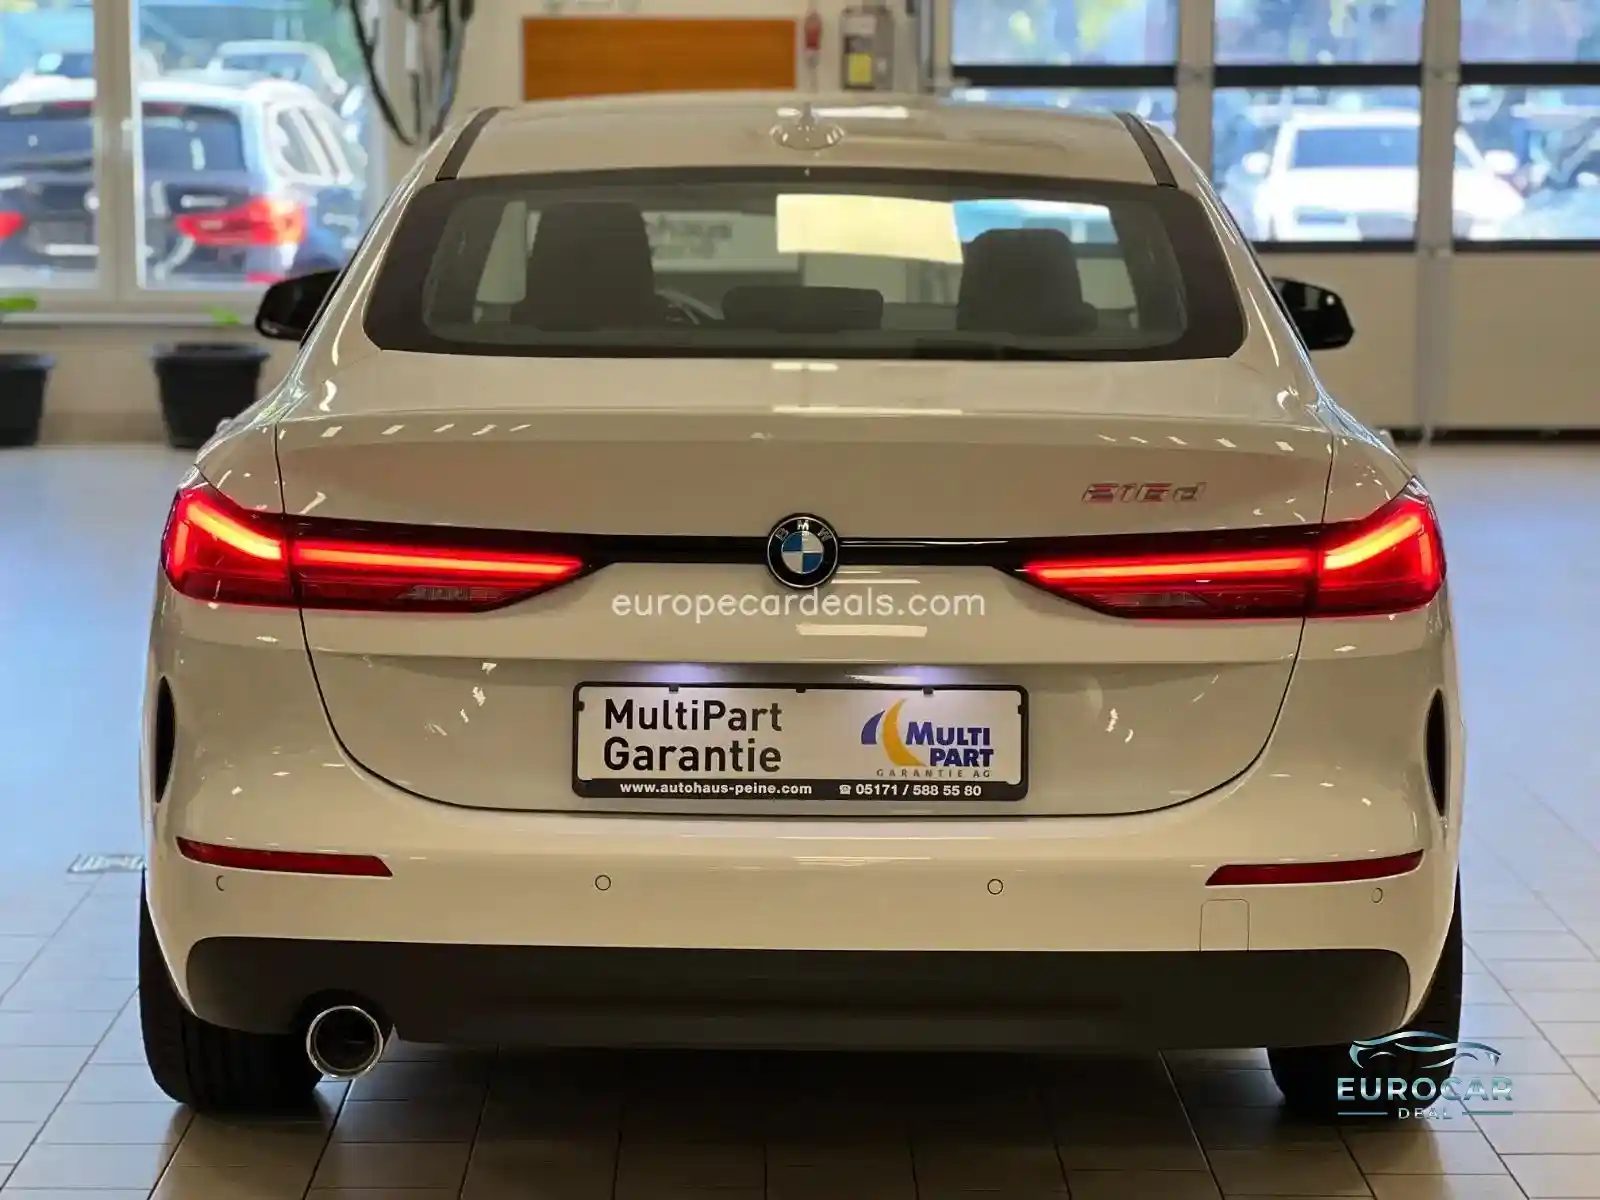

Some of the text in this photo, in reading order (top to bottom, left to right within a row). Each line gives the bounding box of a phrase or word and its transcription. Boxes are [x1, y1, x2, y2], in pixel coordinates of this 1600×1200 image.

[775, 519, 833, 542] BMW
[605, 698, 783, 732] MultiPart
[905, 721, 991, 746] MULTI
[604, 736, 782, 773] Garantie
[930, 748, 994, 767] PART
[876, 768, 991, 778] GARANTIE AG
[620, 782, 813, 796] www.autohaus-peine.com
[856, 784, 982, 796] 05171 / 588 55 80
